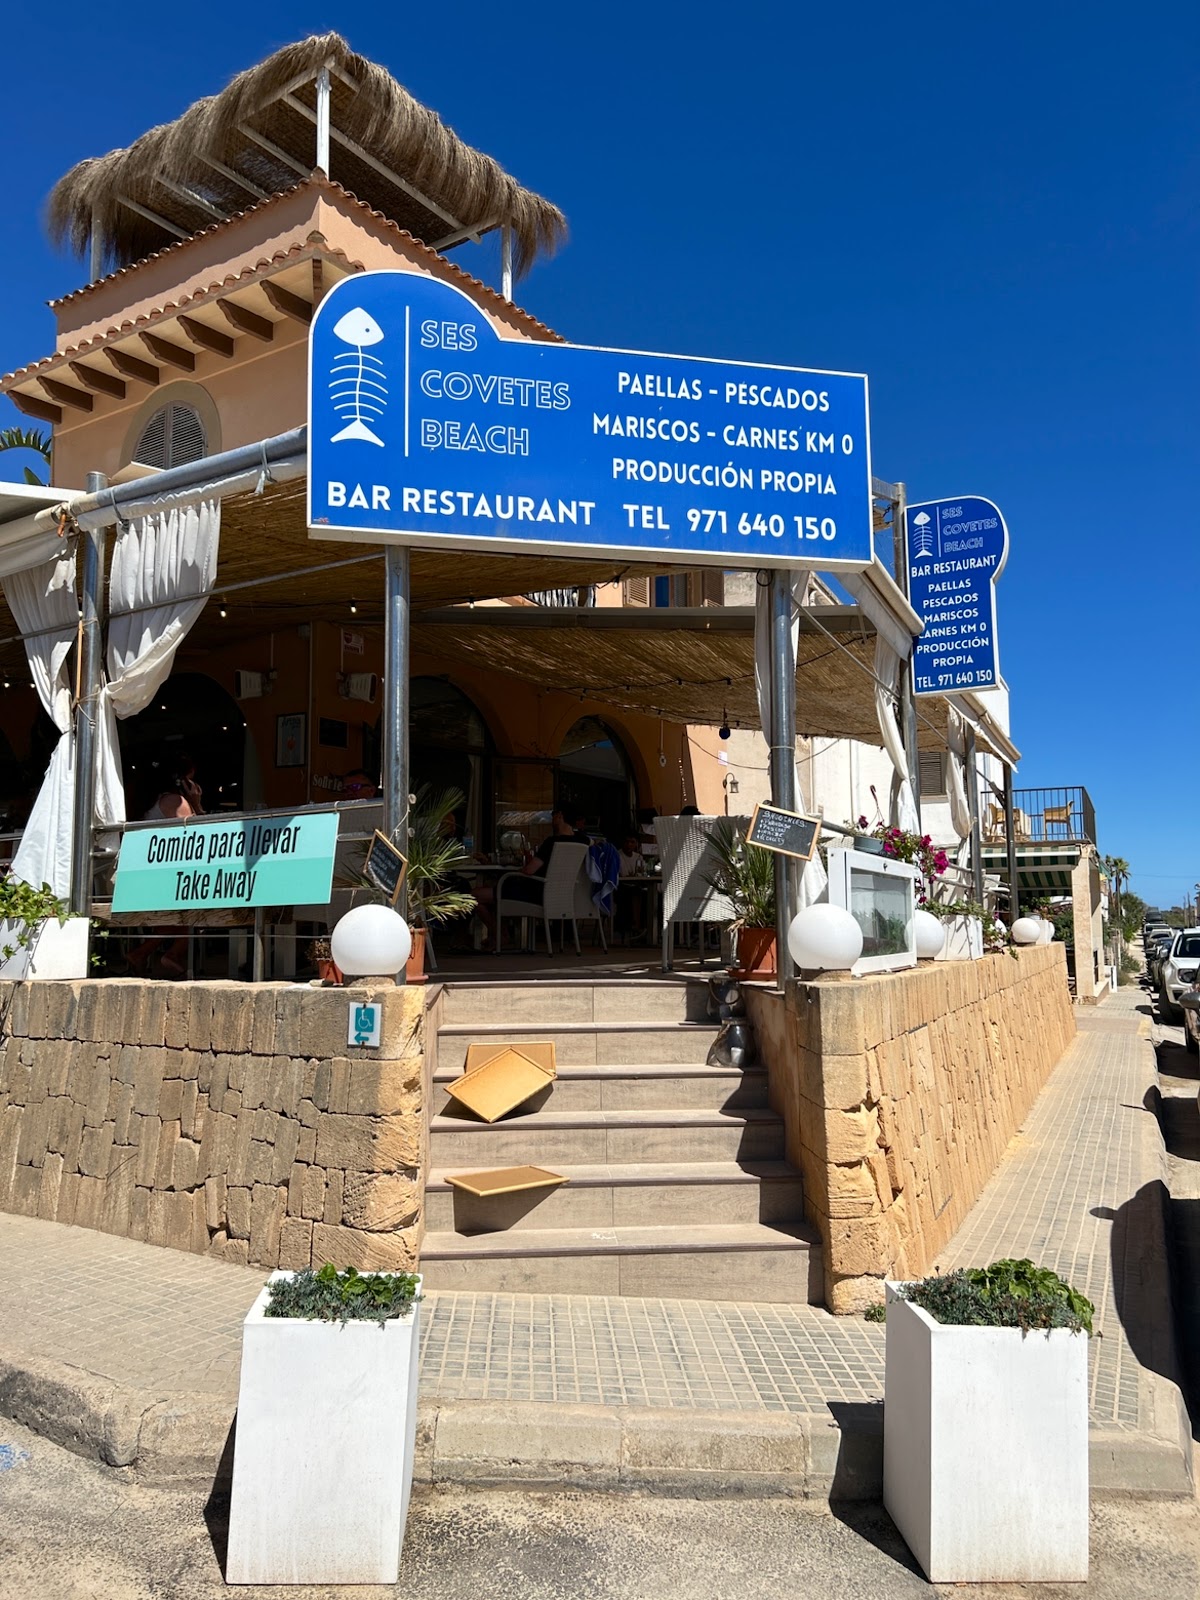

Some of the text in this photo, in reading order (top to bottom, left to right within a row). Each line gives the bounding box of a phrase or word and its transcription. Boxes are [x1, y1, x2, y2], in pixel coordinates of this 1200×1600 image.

[421, 320, 478, 351] SES
[420, 370, 571, 410] COVETES
[618, 372, 702, 400] PAELLAS
[725, 383, 830, 412] PESCADOS
[421, 419, 529, 456] BEACH
[593, 413, 700, 443] MARISCOS
[723, 425, 799, 451] CARNES
[806, 432, 835, 454] KM
[841, 434, 853, 455] 0
[612, 458, 837, 495] PRODUCCIÓN PROPIA
[327, 481, 596, 526] BAR RESTAURANT
[942, 506, 962, 519] SES
[623, 504, 836, 541] TEL 971 640 150
[943, 517, 997, 535] COVETES
[944, 537, 983, 552] BEACH
[911, 554, 996, 577] BAR RESTAURANT
[928, 578, 971, 592] PAELLAS
[923, 592, 978, 608] PESCADOS
[923, 608, 978, 623] MARISCOS
[919, 622, 986, 638] ARNES KM 0
[916, 636, 988, 653] PRODUCCIÓN
[932, 655, 973, 666] PROPIA
[916, 669, 992, 687] TEL. 971 640 150
[148, 825, 301, 863] Comida para llevar
[175, 868, 257, 902] Take Away
